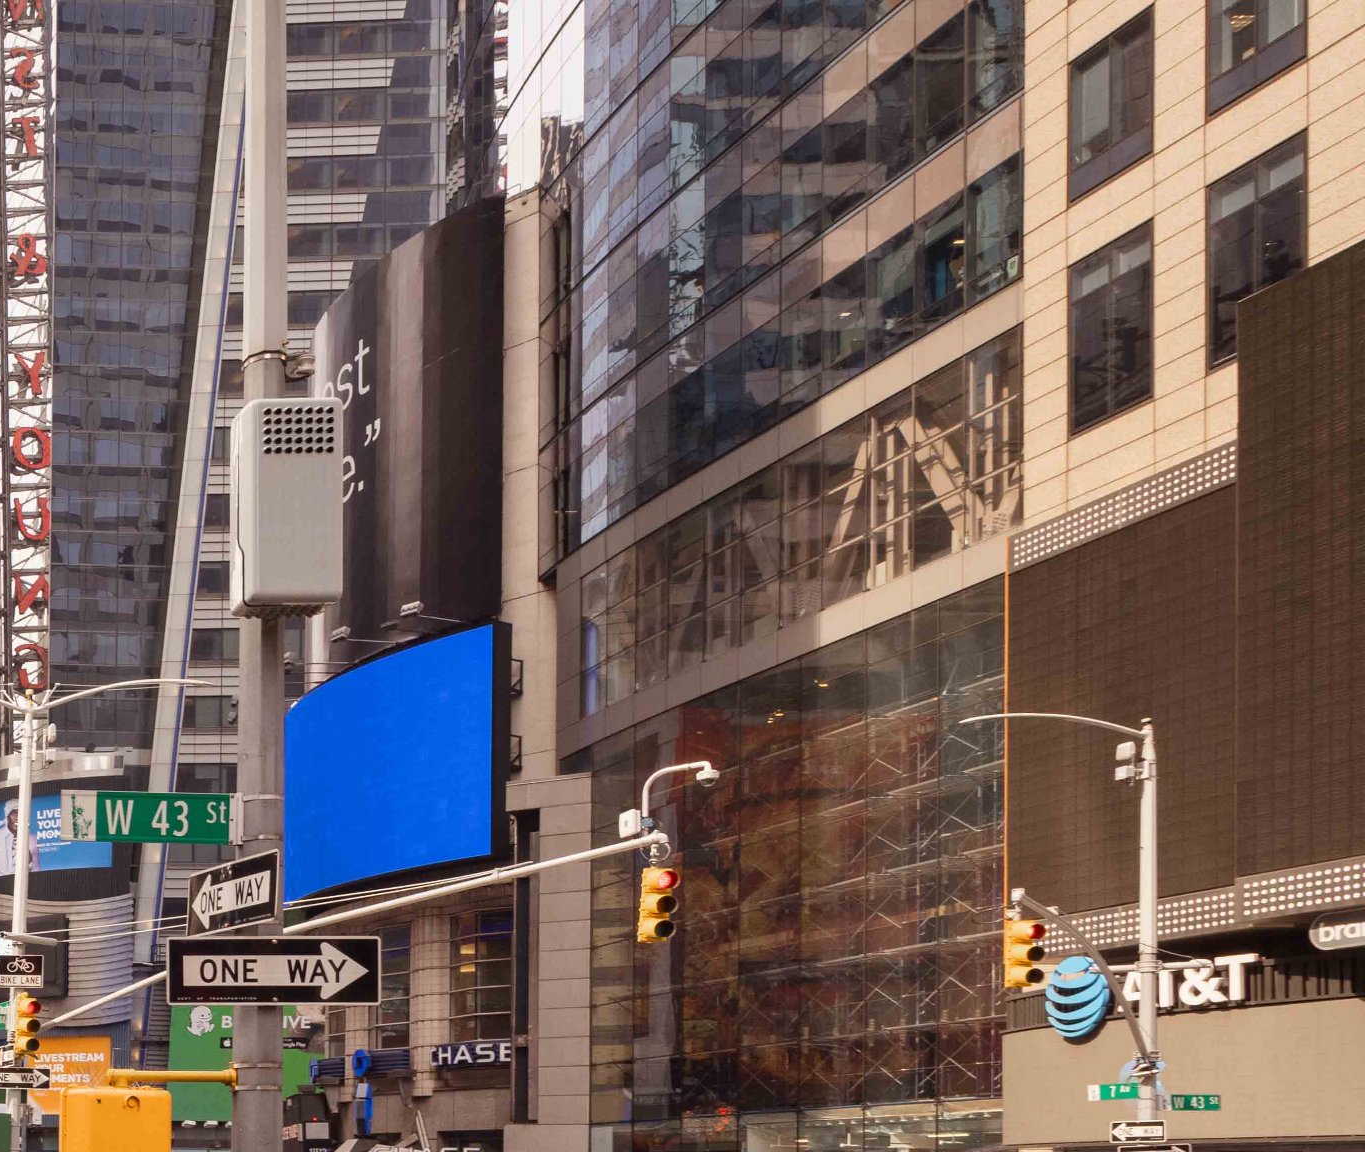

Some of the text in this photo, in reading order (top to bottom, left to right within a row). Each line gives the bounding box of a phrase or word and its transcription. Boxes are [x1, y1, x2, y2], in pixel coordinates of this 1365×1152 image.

[105, 799, 227, 837] W 43 St
[200, 876, 264, 915] ONE WAY
[200, 958, 348, 984] ONE WAY
[0, 976, 41, 985] BIKE LANE
[1118, 953, 1260, 1008] AT&T
[283, 1016, 311, 1029] IVE
[430, 1042, 511, 1065] CHASE
[20, 1074, 42, 1082] WAY
[51, 1074, 90, 1083] MENTS
[1109, 1085, 1117, 1098] 7
[1173, 1096, 1185, 1109] W
[1189, 1096, 1205, 1109] 43
[1118, 1126, 1159, 1136] ONE WAY
